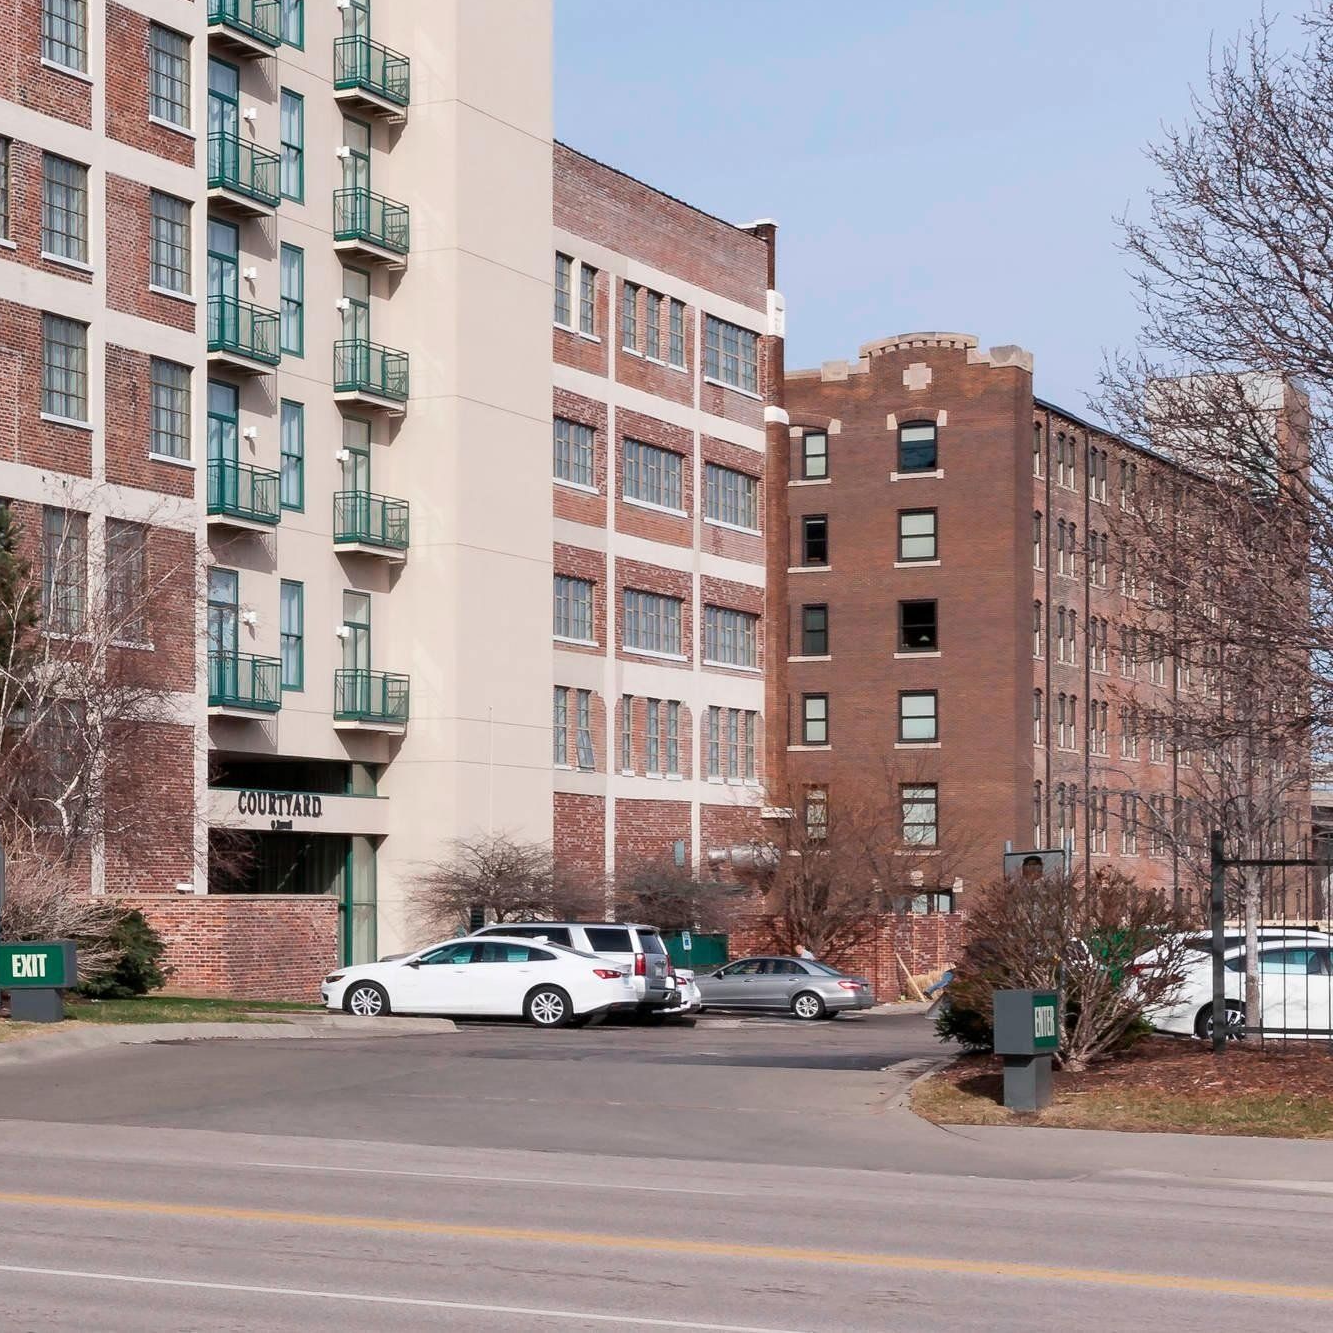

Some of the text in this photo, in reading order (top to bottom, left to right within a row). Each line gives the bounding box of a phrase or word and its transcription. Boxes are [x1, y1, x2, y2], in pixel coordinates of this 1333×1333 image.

[237, 791, 321, 818] COURTYARD
[12, 954, 48, 978] EXIT
[1034, 1006, 1055, 1038] ENTER
